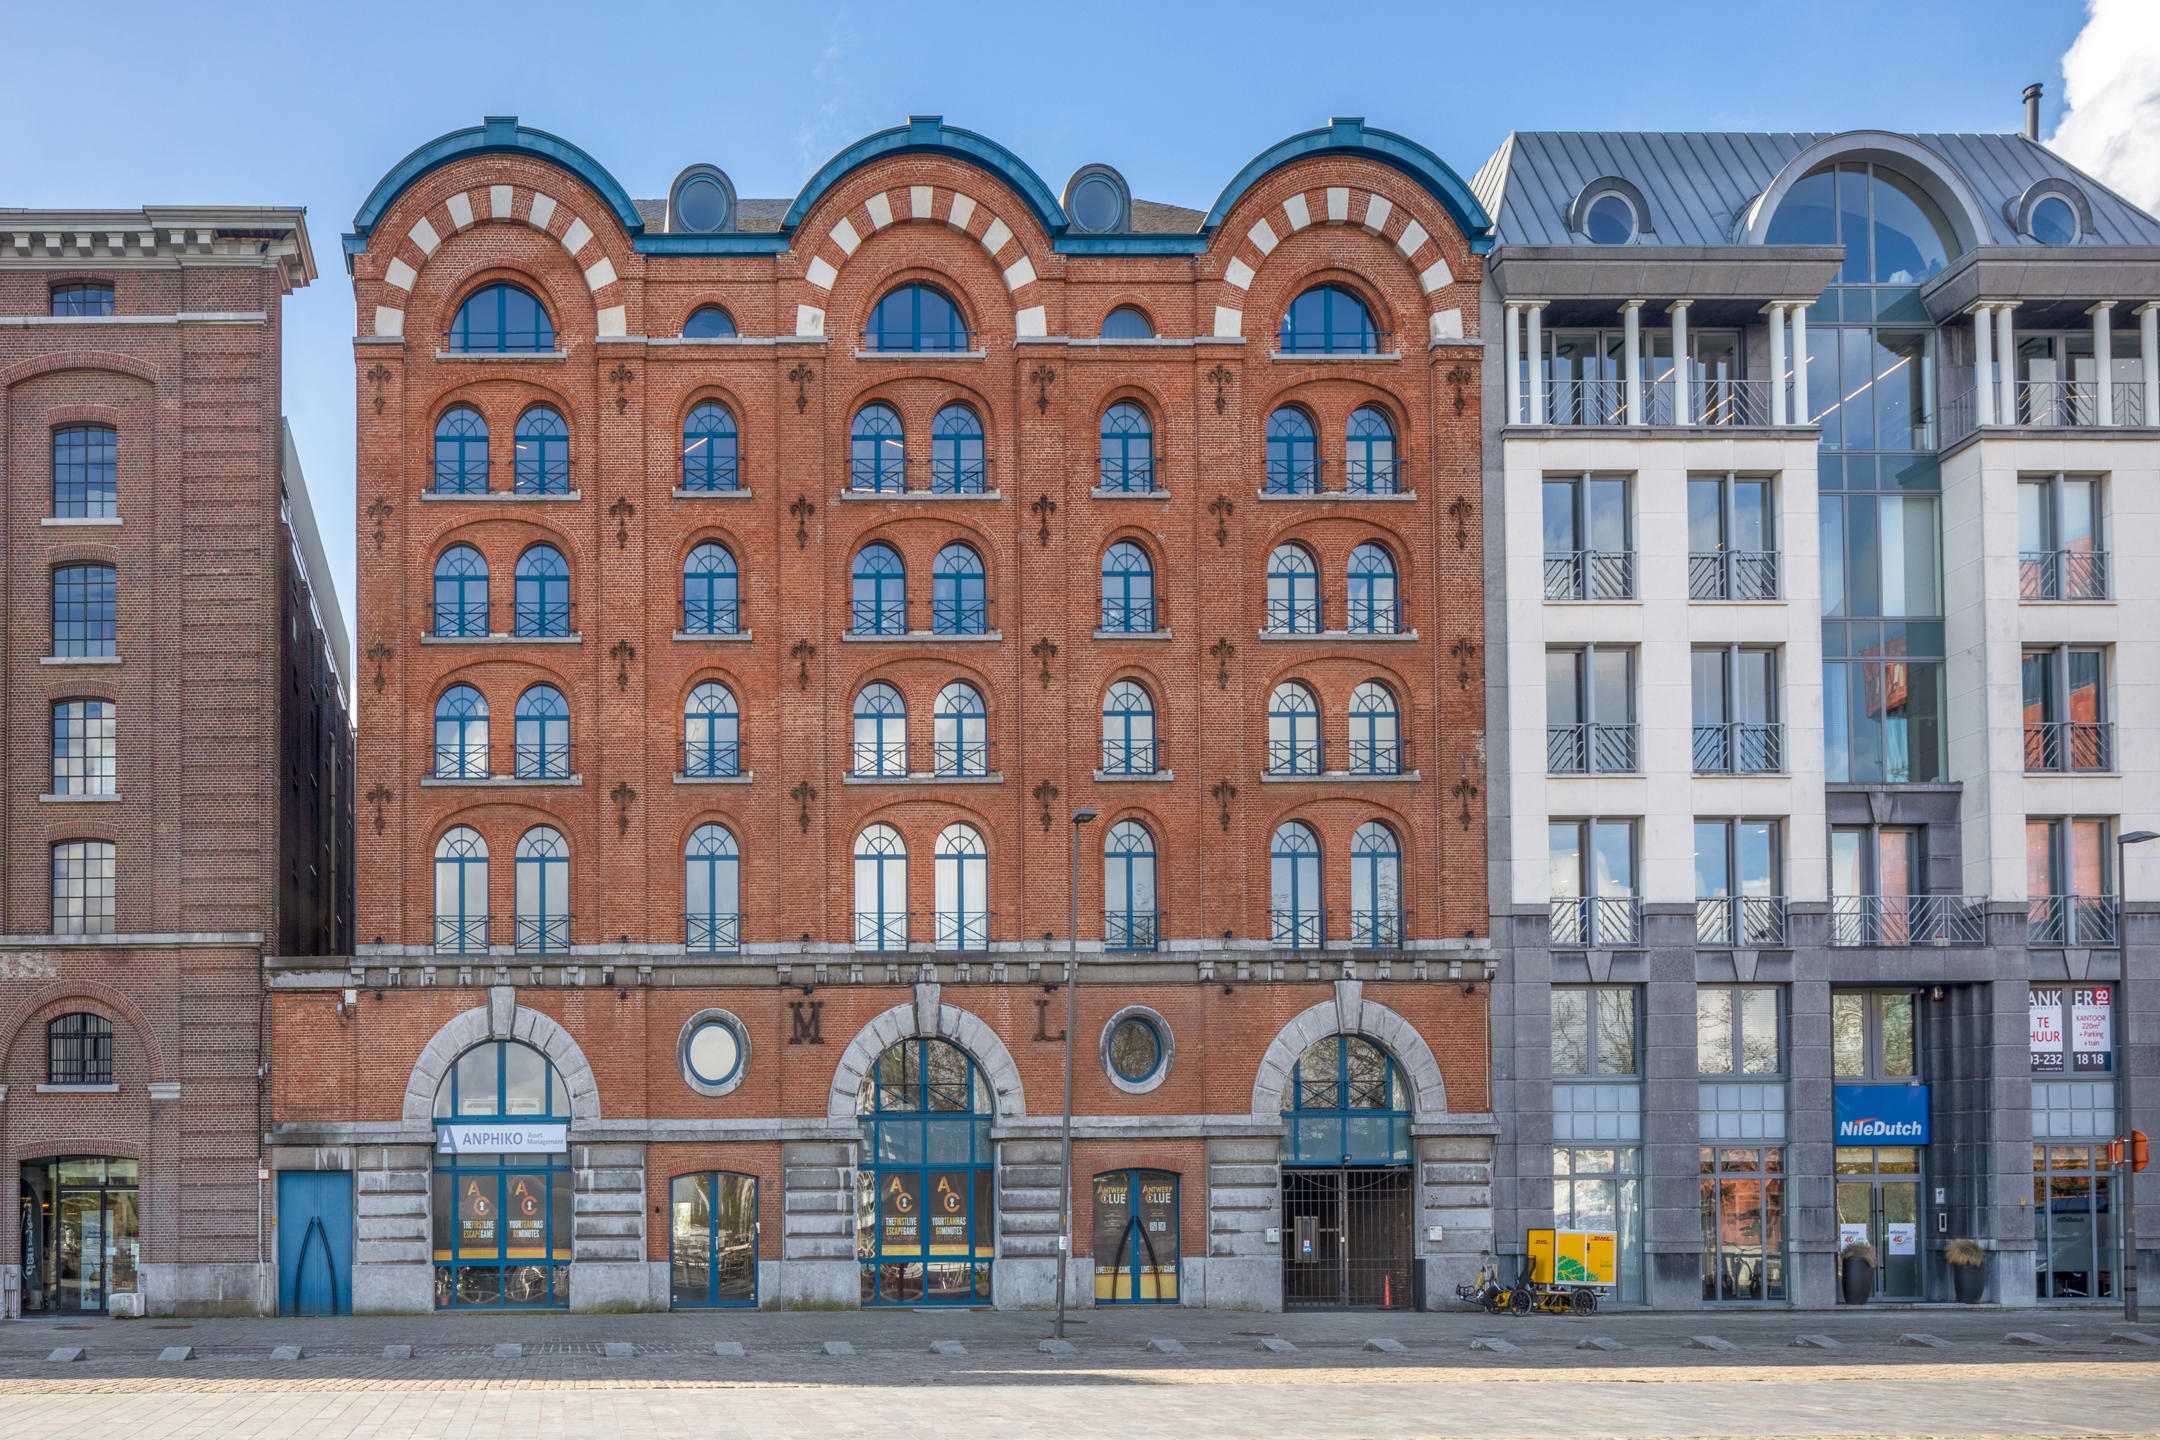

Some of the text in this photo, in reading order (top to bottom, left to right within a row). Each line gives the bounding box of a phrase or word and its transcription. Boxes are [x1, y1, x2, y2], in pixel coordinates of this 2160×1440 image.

[789, 1001, 824, 1044] M
[1034, 999, 1066, 1041] L
[2037, 1017, 2050, 1028] TE
[2084, 1031, 2104, 1039] Parking
[2076, 1054, 2104, 1065] 18 18
[1840, 1121, 1922, 1136] NileDutch
[462, 1132, 523, 1145] ANPHIKO
